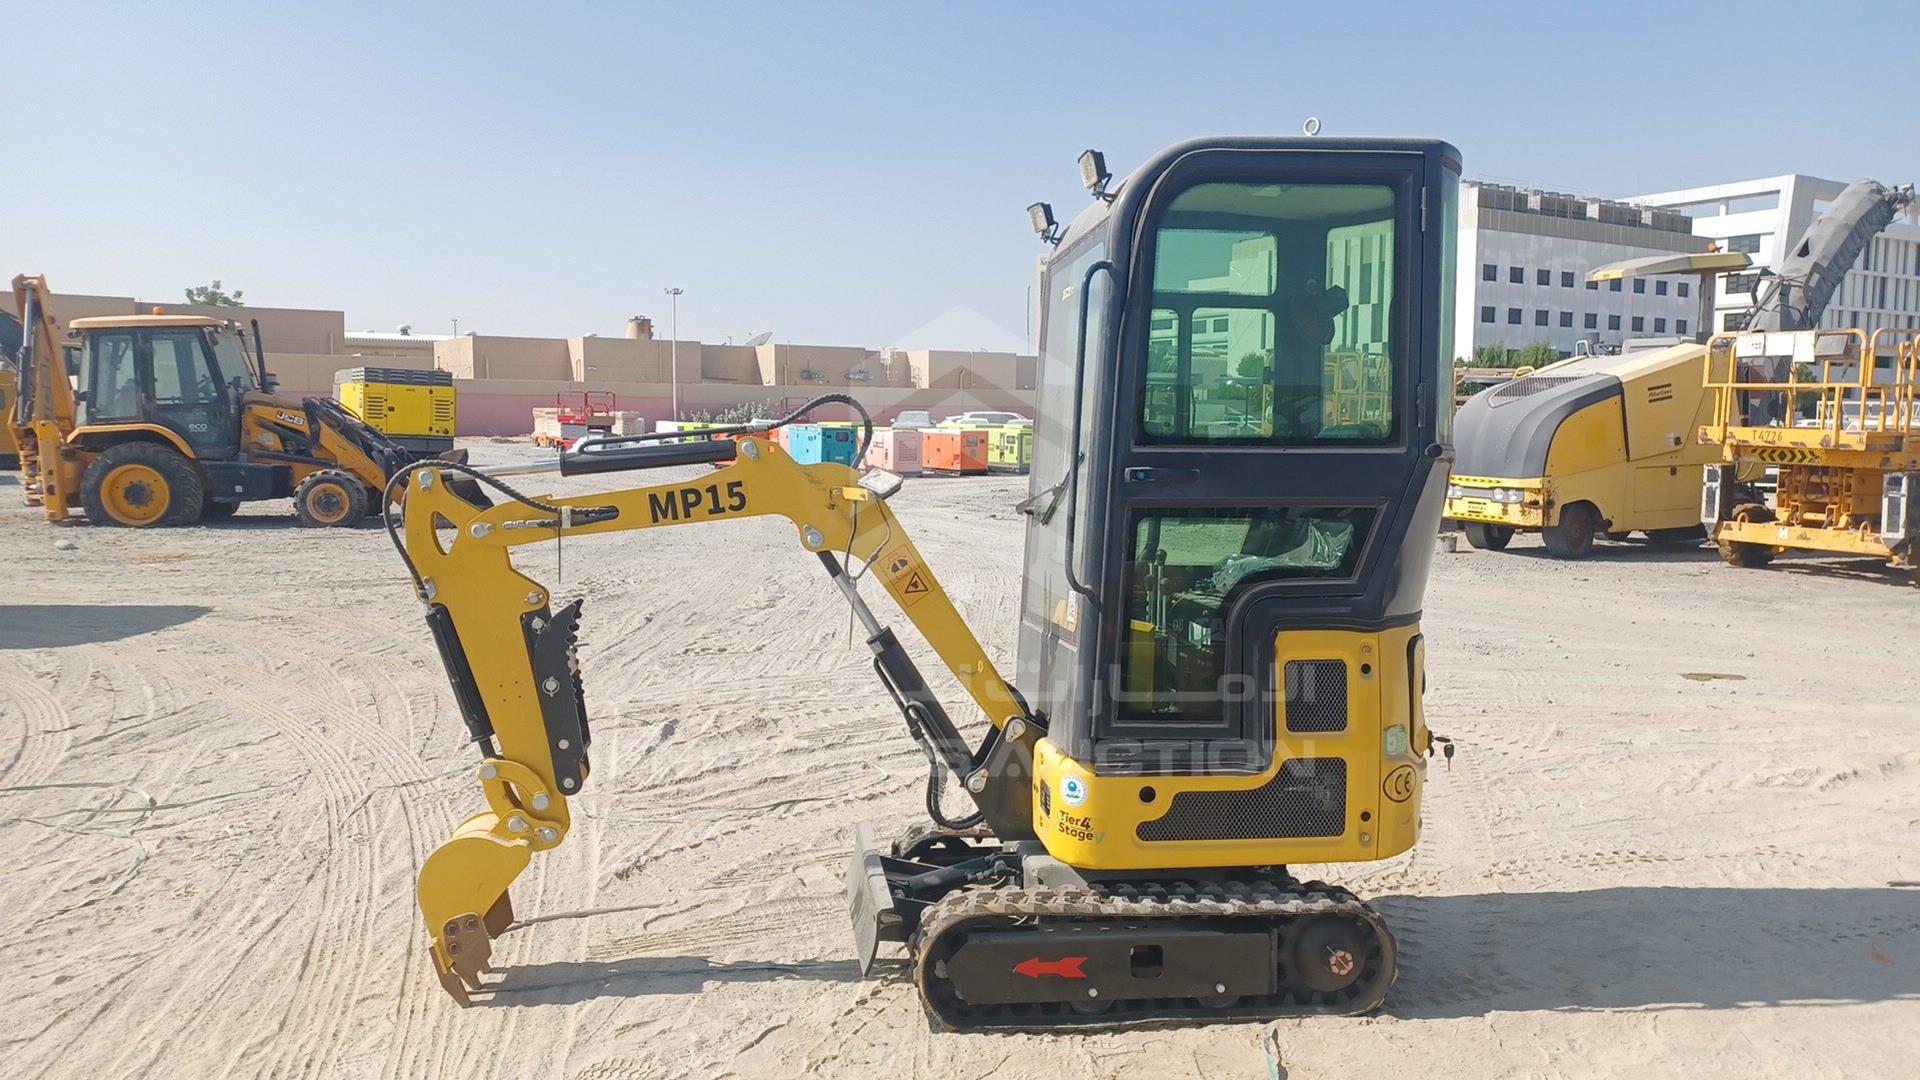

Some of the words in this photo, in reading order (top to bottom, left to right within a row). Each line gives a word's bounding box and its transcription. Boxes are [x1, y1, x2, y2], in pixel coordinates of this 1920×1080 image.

[188, 422, 208, 430] eco
[276, 409, 304, 426] JCB
[648, 480, 747, 524] MP15
[1058, 821, 1094, 842] Stage
